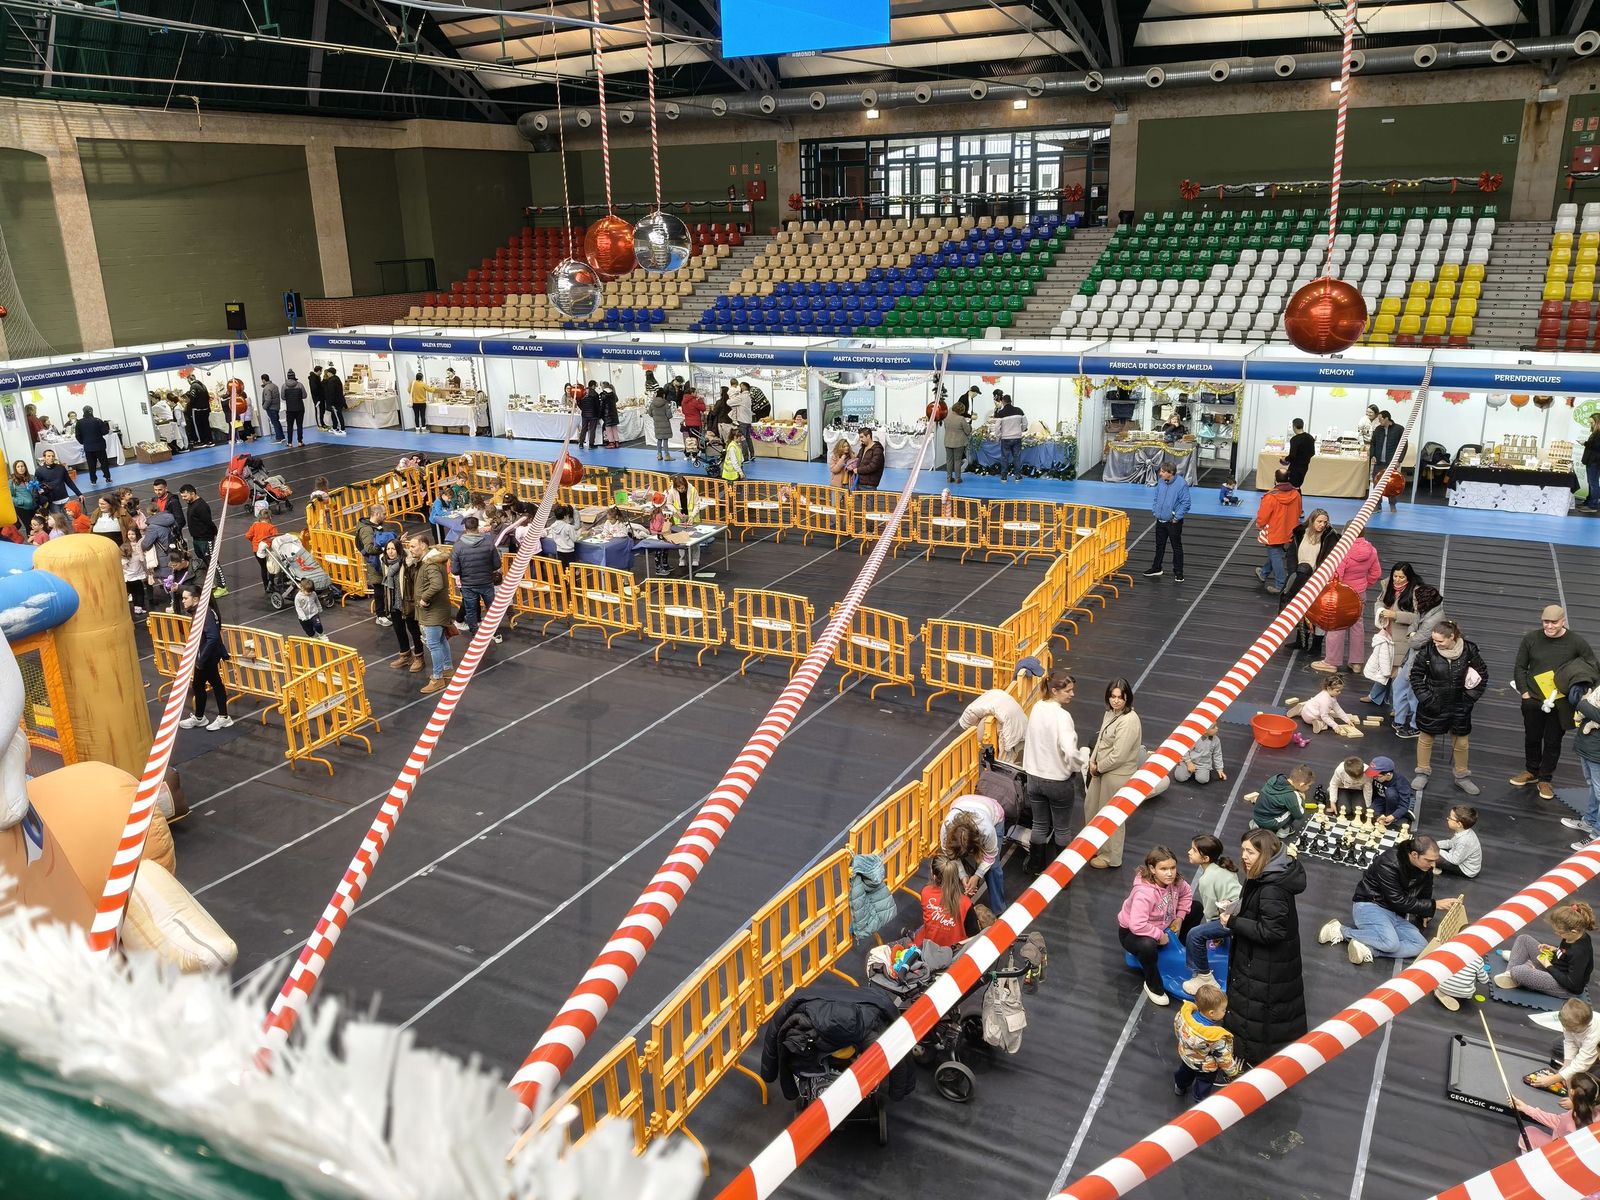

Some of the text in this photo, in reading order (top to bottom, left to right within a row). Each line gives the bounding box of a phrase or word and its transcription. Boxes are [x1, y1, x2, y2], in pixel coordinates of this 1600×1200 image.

[1109, 361, 1137, 369] FÁBRICA
[22, 373, 45, 382] ASOCIACIÓN
[1495, 374, 1561, 383] PERENDENGUES
[1450, 1094, 1486, 1107] GEOLOGIC
